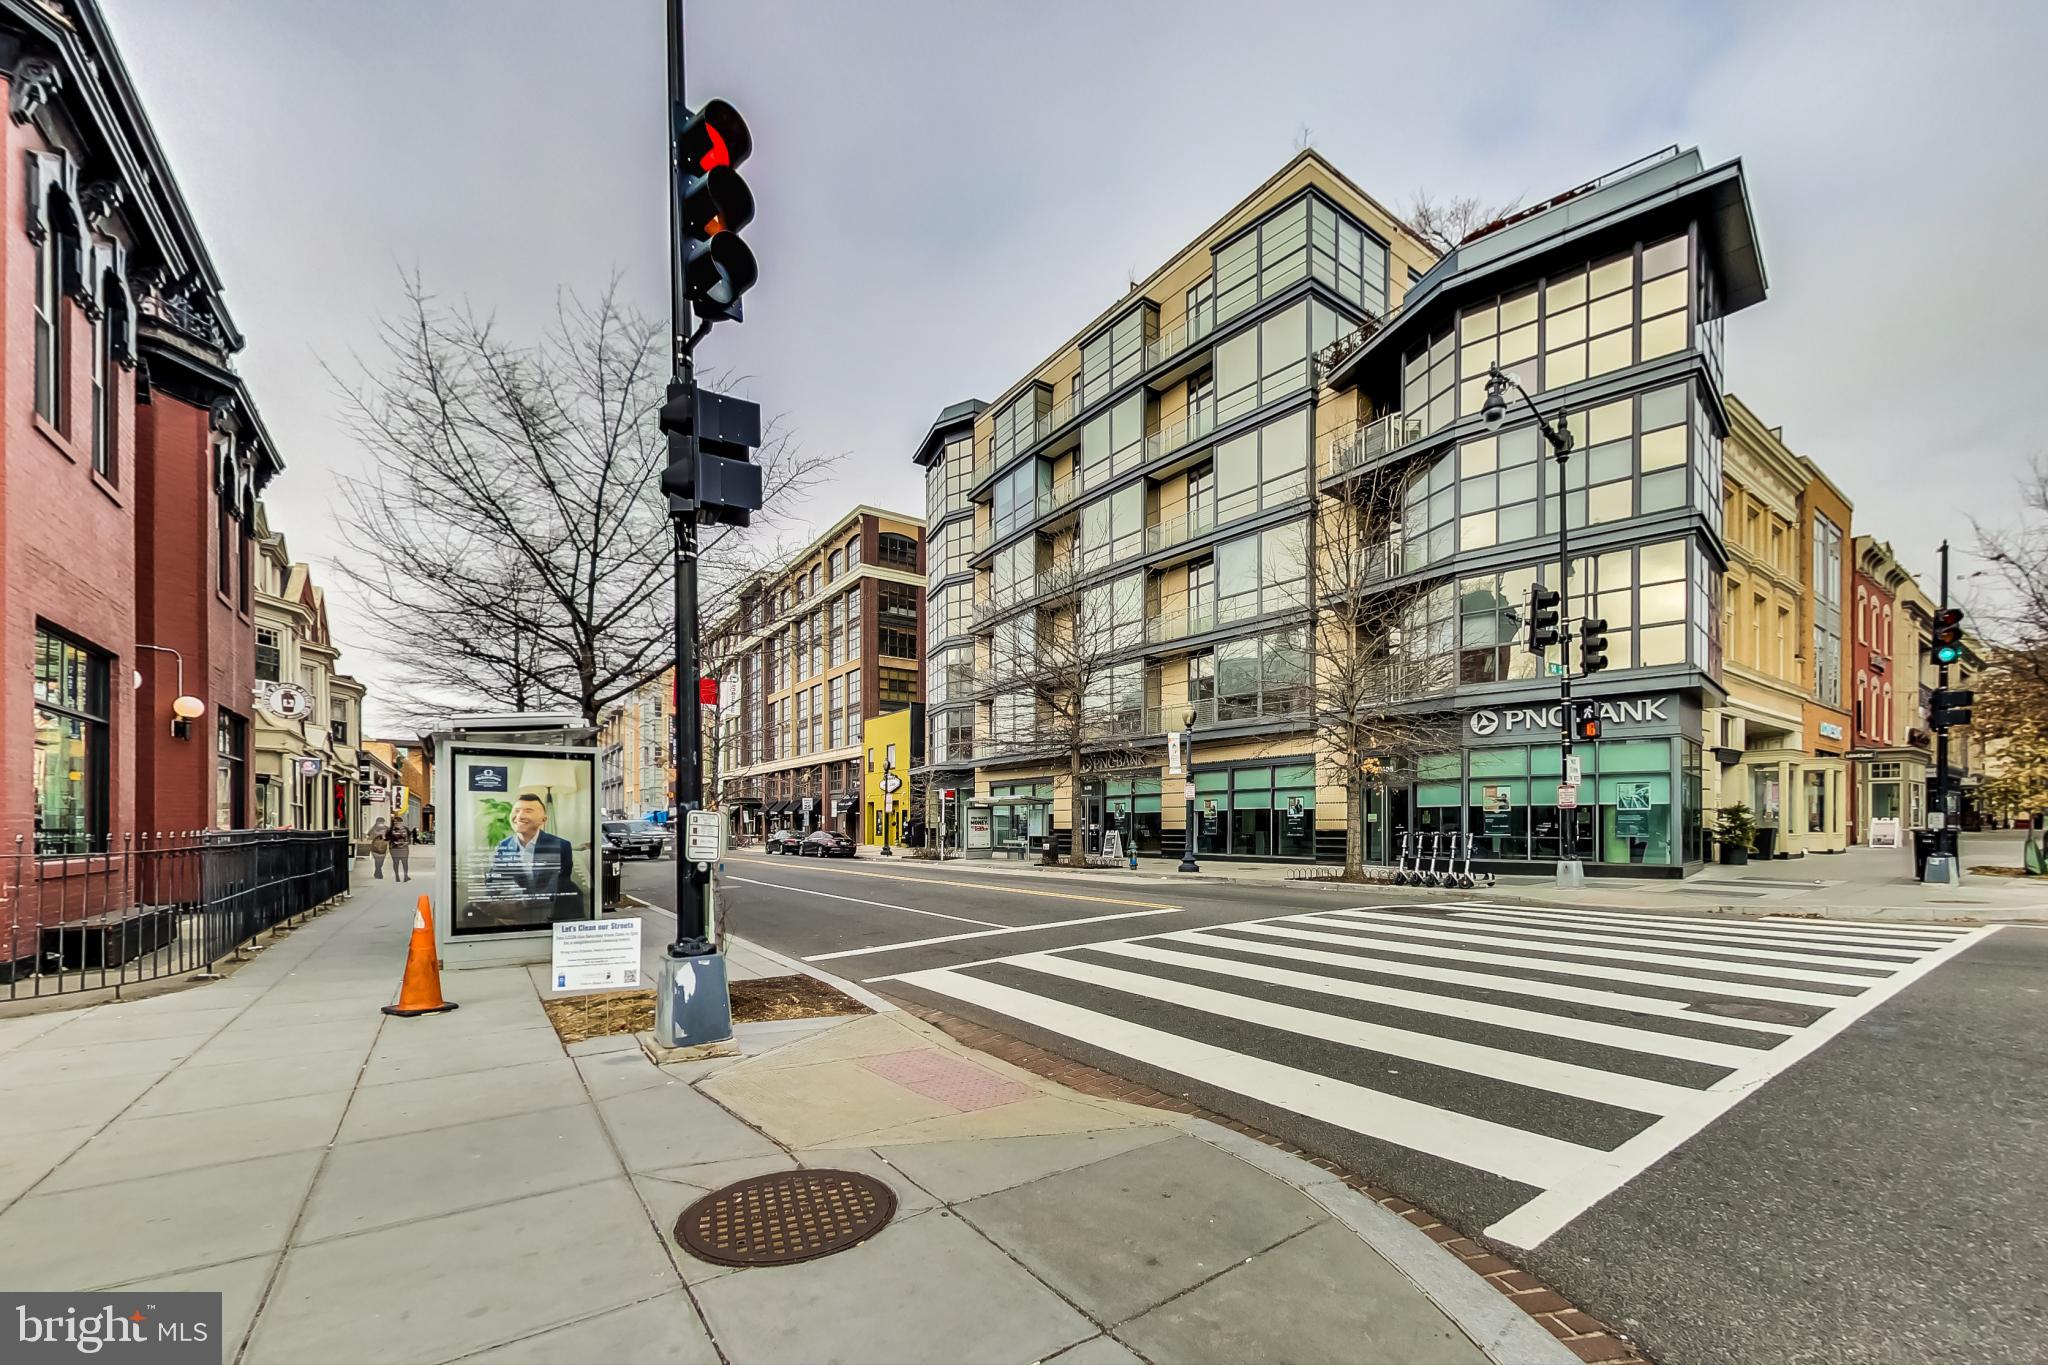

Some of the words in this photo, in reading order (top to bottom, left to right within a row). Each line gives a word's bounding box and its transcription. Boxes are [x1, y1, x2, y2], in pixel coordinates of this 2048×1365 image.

[1503, 705, 1562, 730] PNC
[1600, 697, 1668, 724] ANK
[1093, 756, 1115, 769] PNC
[1116, 752, 1145, 768] BANK
[561, 924, 577, 933] Let's
[578, 924, 596, 932] Clean
[611, 922, 634, 930] Streets
